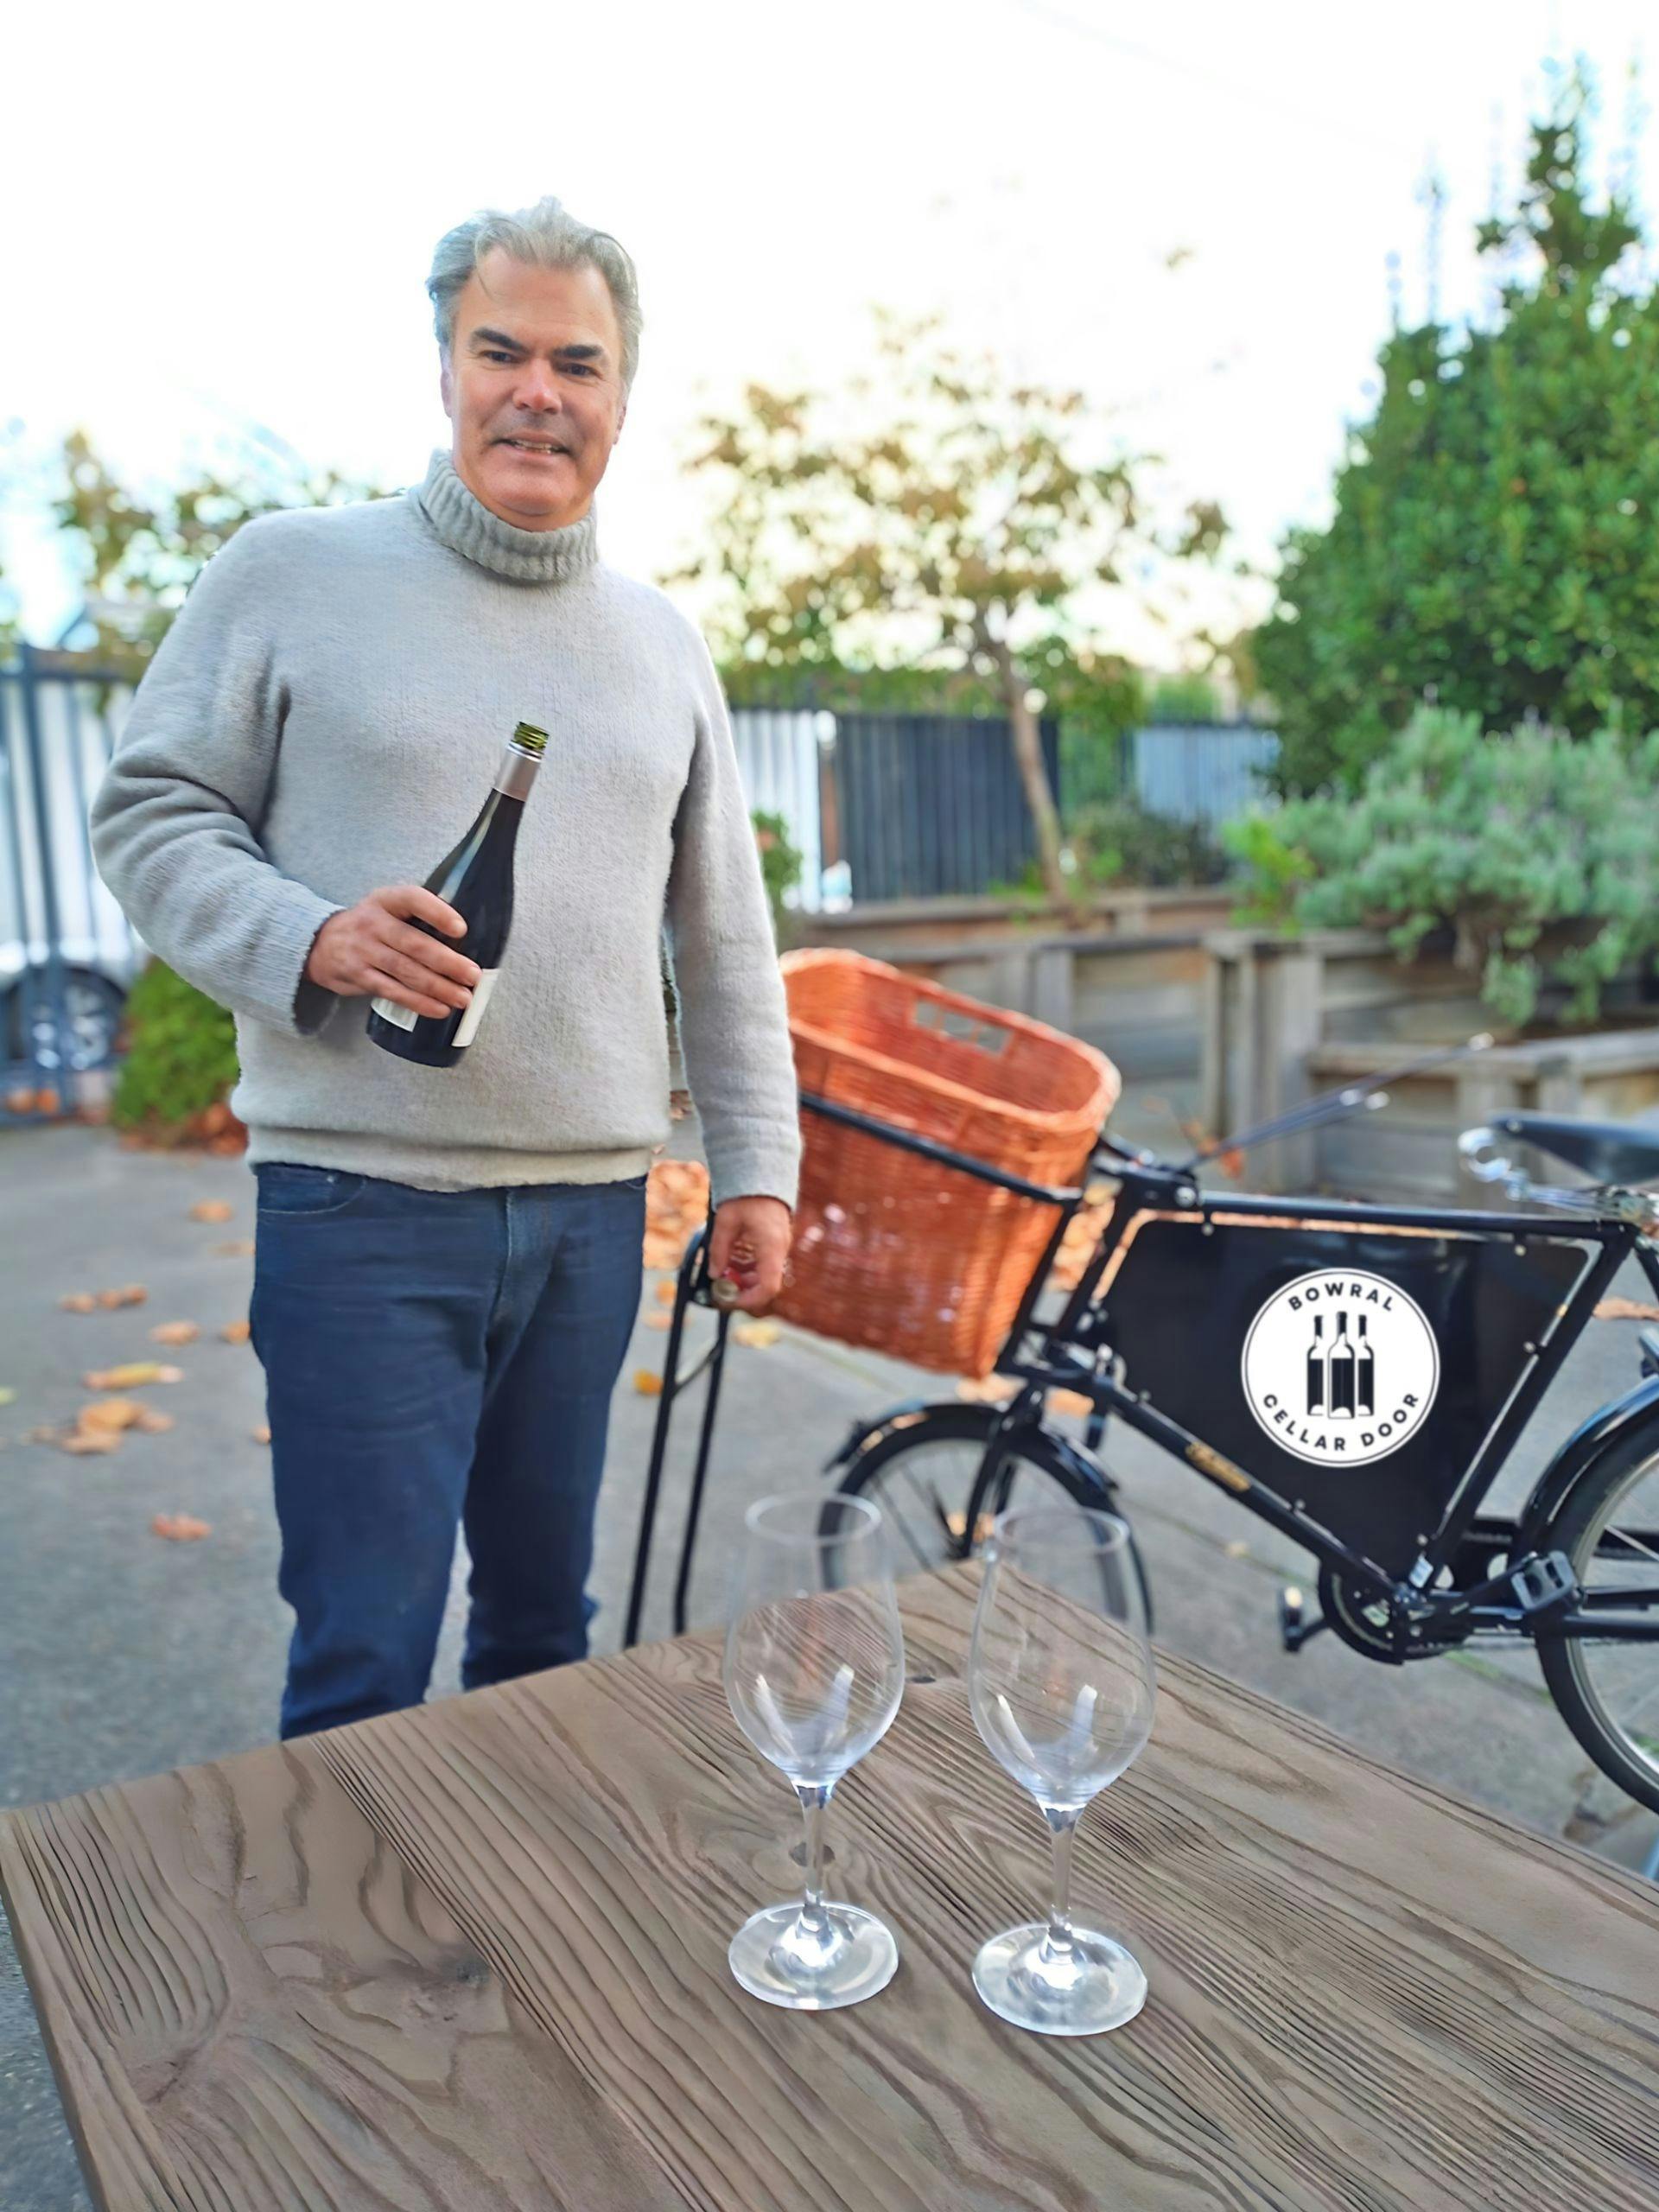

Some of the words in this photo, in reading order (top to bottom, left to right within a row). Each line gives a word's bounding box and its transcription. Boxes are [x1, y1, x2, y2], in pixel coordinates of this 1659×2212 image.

[1288, 1282, 1393, 1312] BOWRAL
[1263, 1394, 1346, 1452] CELLAR
[1360, 1394, 1419, 1447] DOOR
